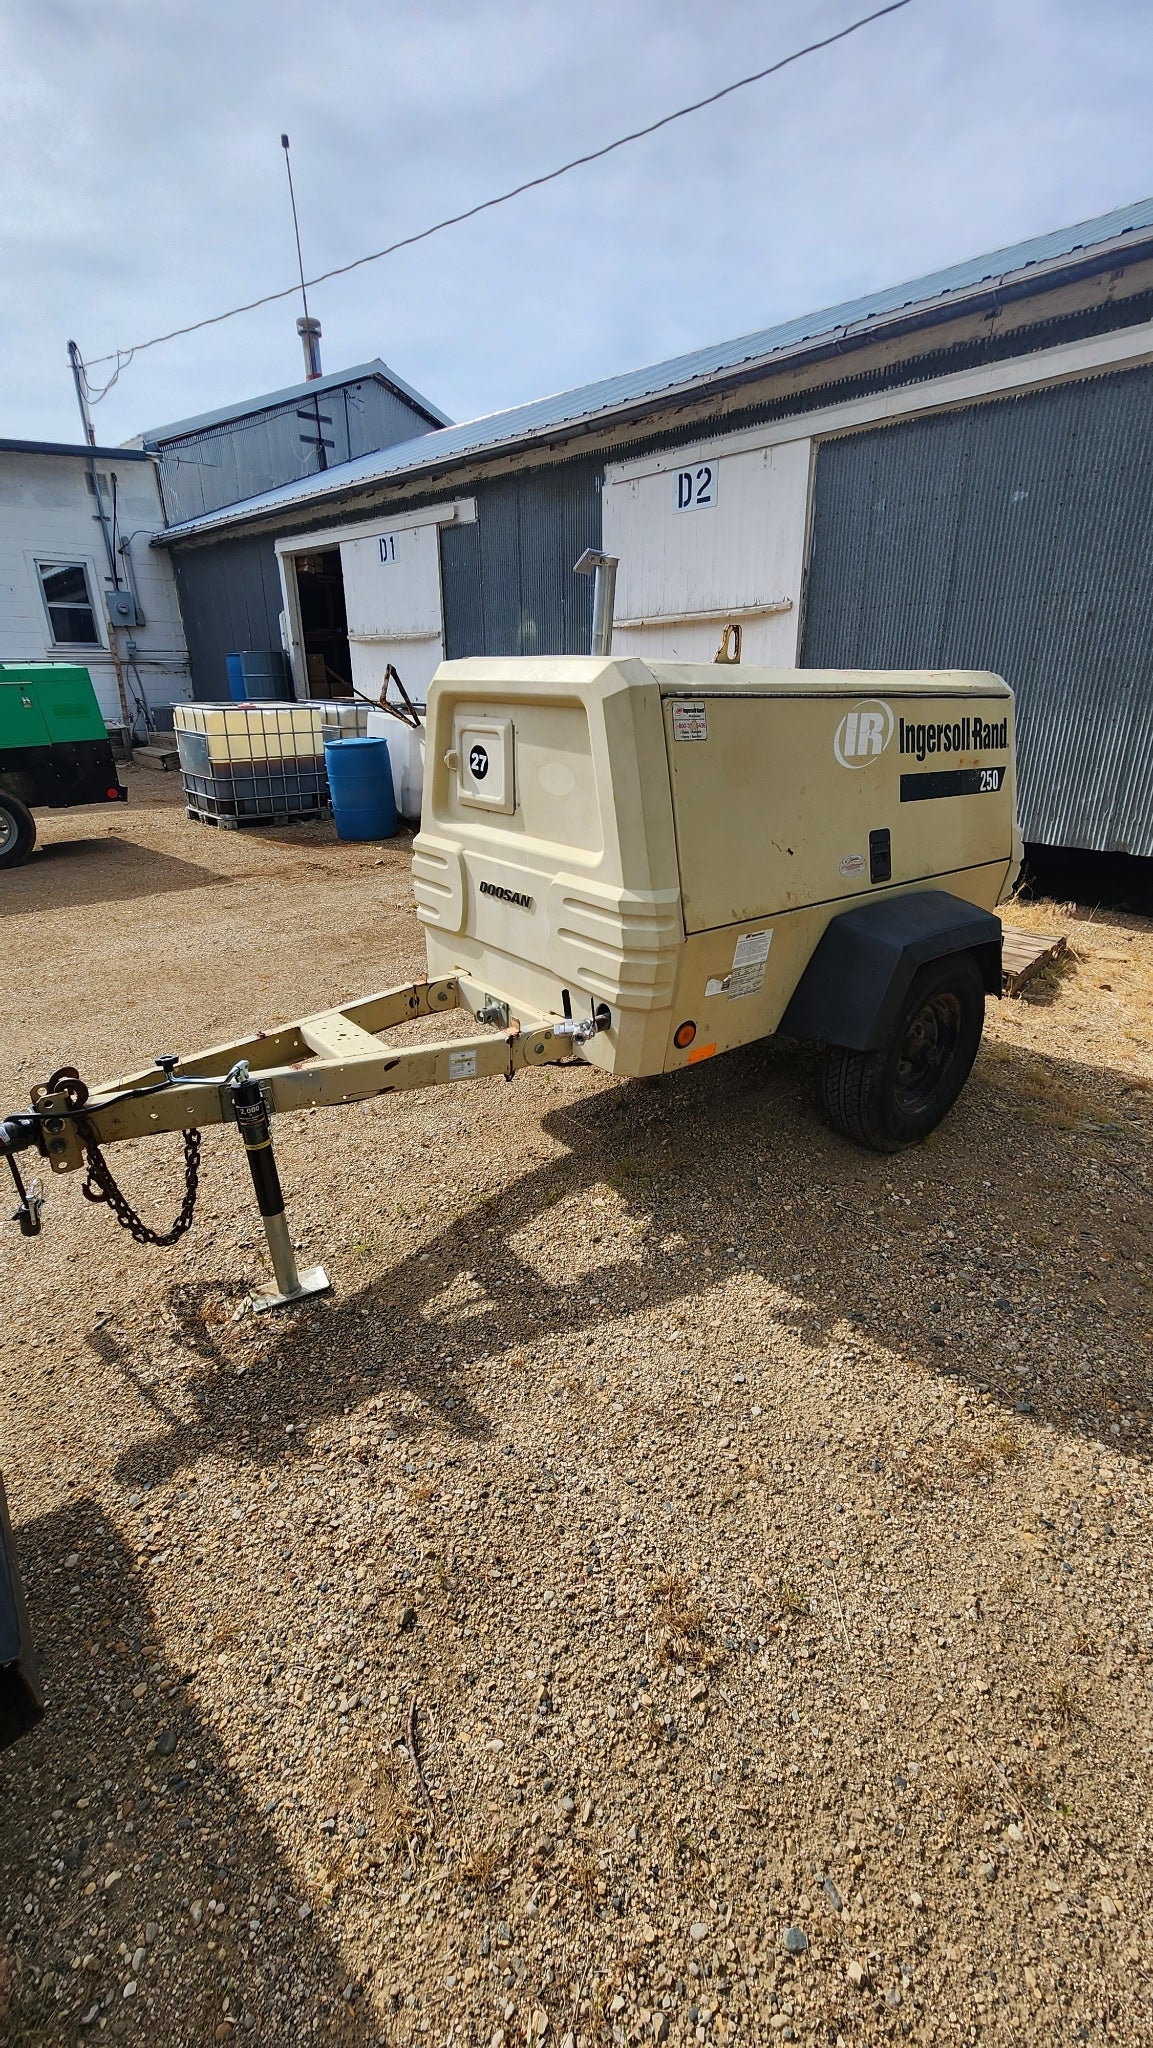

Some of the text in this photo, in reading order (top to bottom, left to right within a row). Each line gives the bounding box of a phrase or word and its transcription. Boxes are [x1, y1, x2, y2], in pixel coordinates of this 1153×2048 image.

[678, 467, 712, 509] D2
[379, 536, 395, 562] D1
[844, 712, 885, 757] IR
[899, 717, 1008, 762] Ingersoll-Rand
[471, 752, 487, 772] 27
[980, 770, 999, 791] 250
[480, 880, 533, 909] DOOSAN
[240, 1105, 260, 1116] 2,000
